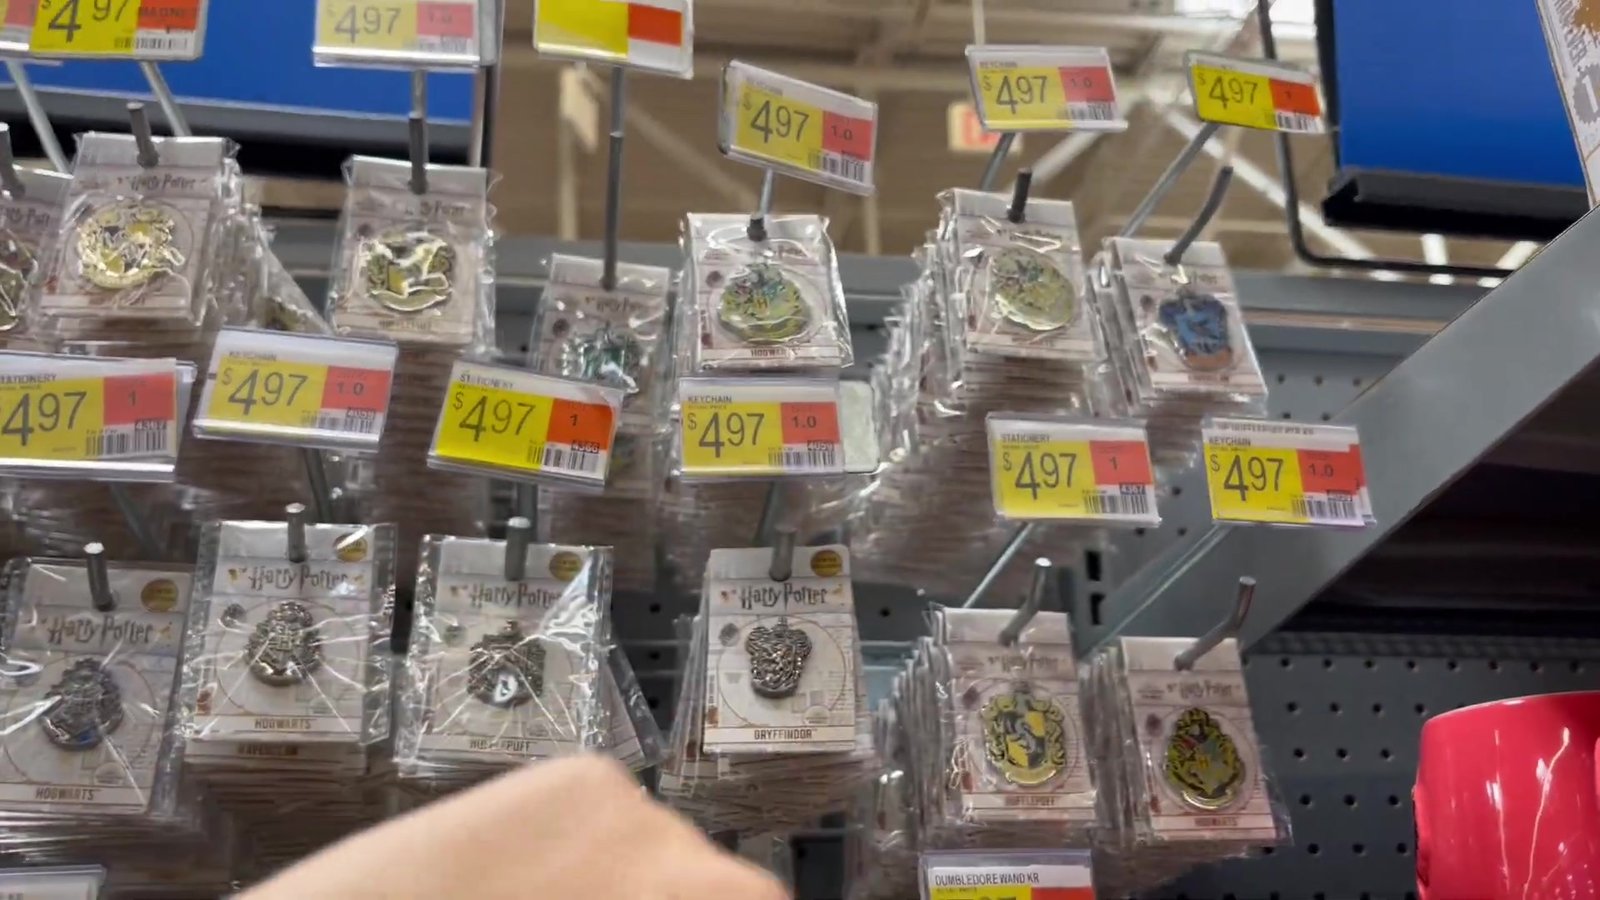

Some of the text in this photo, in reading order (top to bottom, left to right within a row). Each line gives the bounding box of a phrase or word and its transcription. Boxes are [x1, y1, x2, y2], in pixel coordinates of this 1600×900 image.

[221, 367, 309, 416] $497
[453, 391, 537, 443] $497
[687, 411, 766, 459] $497
[1003, 451, 1078, 501] $497
[1210, 453, 1285, 502] $497
[248, 564, 348, 590] Harry Potter
[469, 583, 512, 608] Harry
[741, 582, 828, 610] Harry Potter
[47, 614, 154, 644] Harry Potter
[254, 718, 312, 730] HOGWARTS
[753, 728, 813, 741] GRYFFINDOR
[935, 872, 1041, 887] DUMBLEDORE WAND KR
